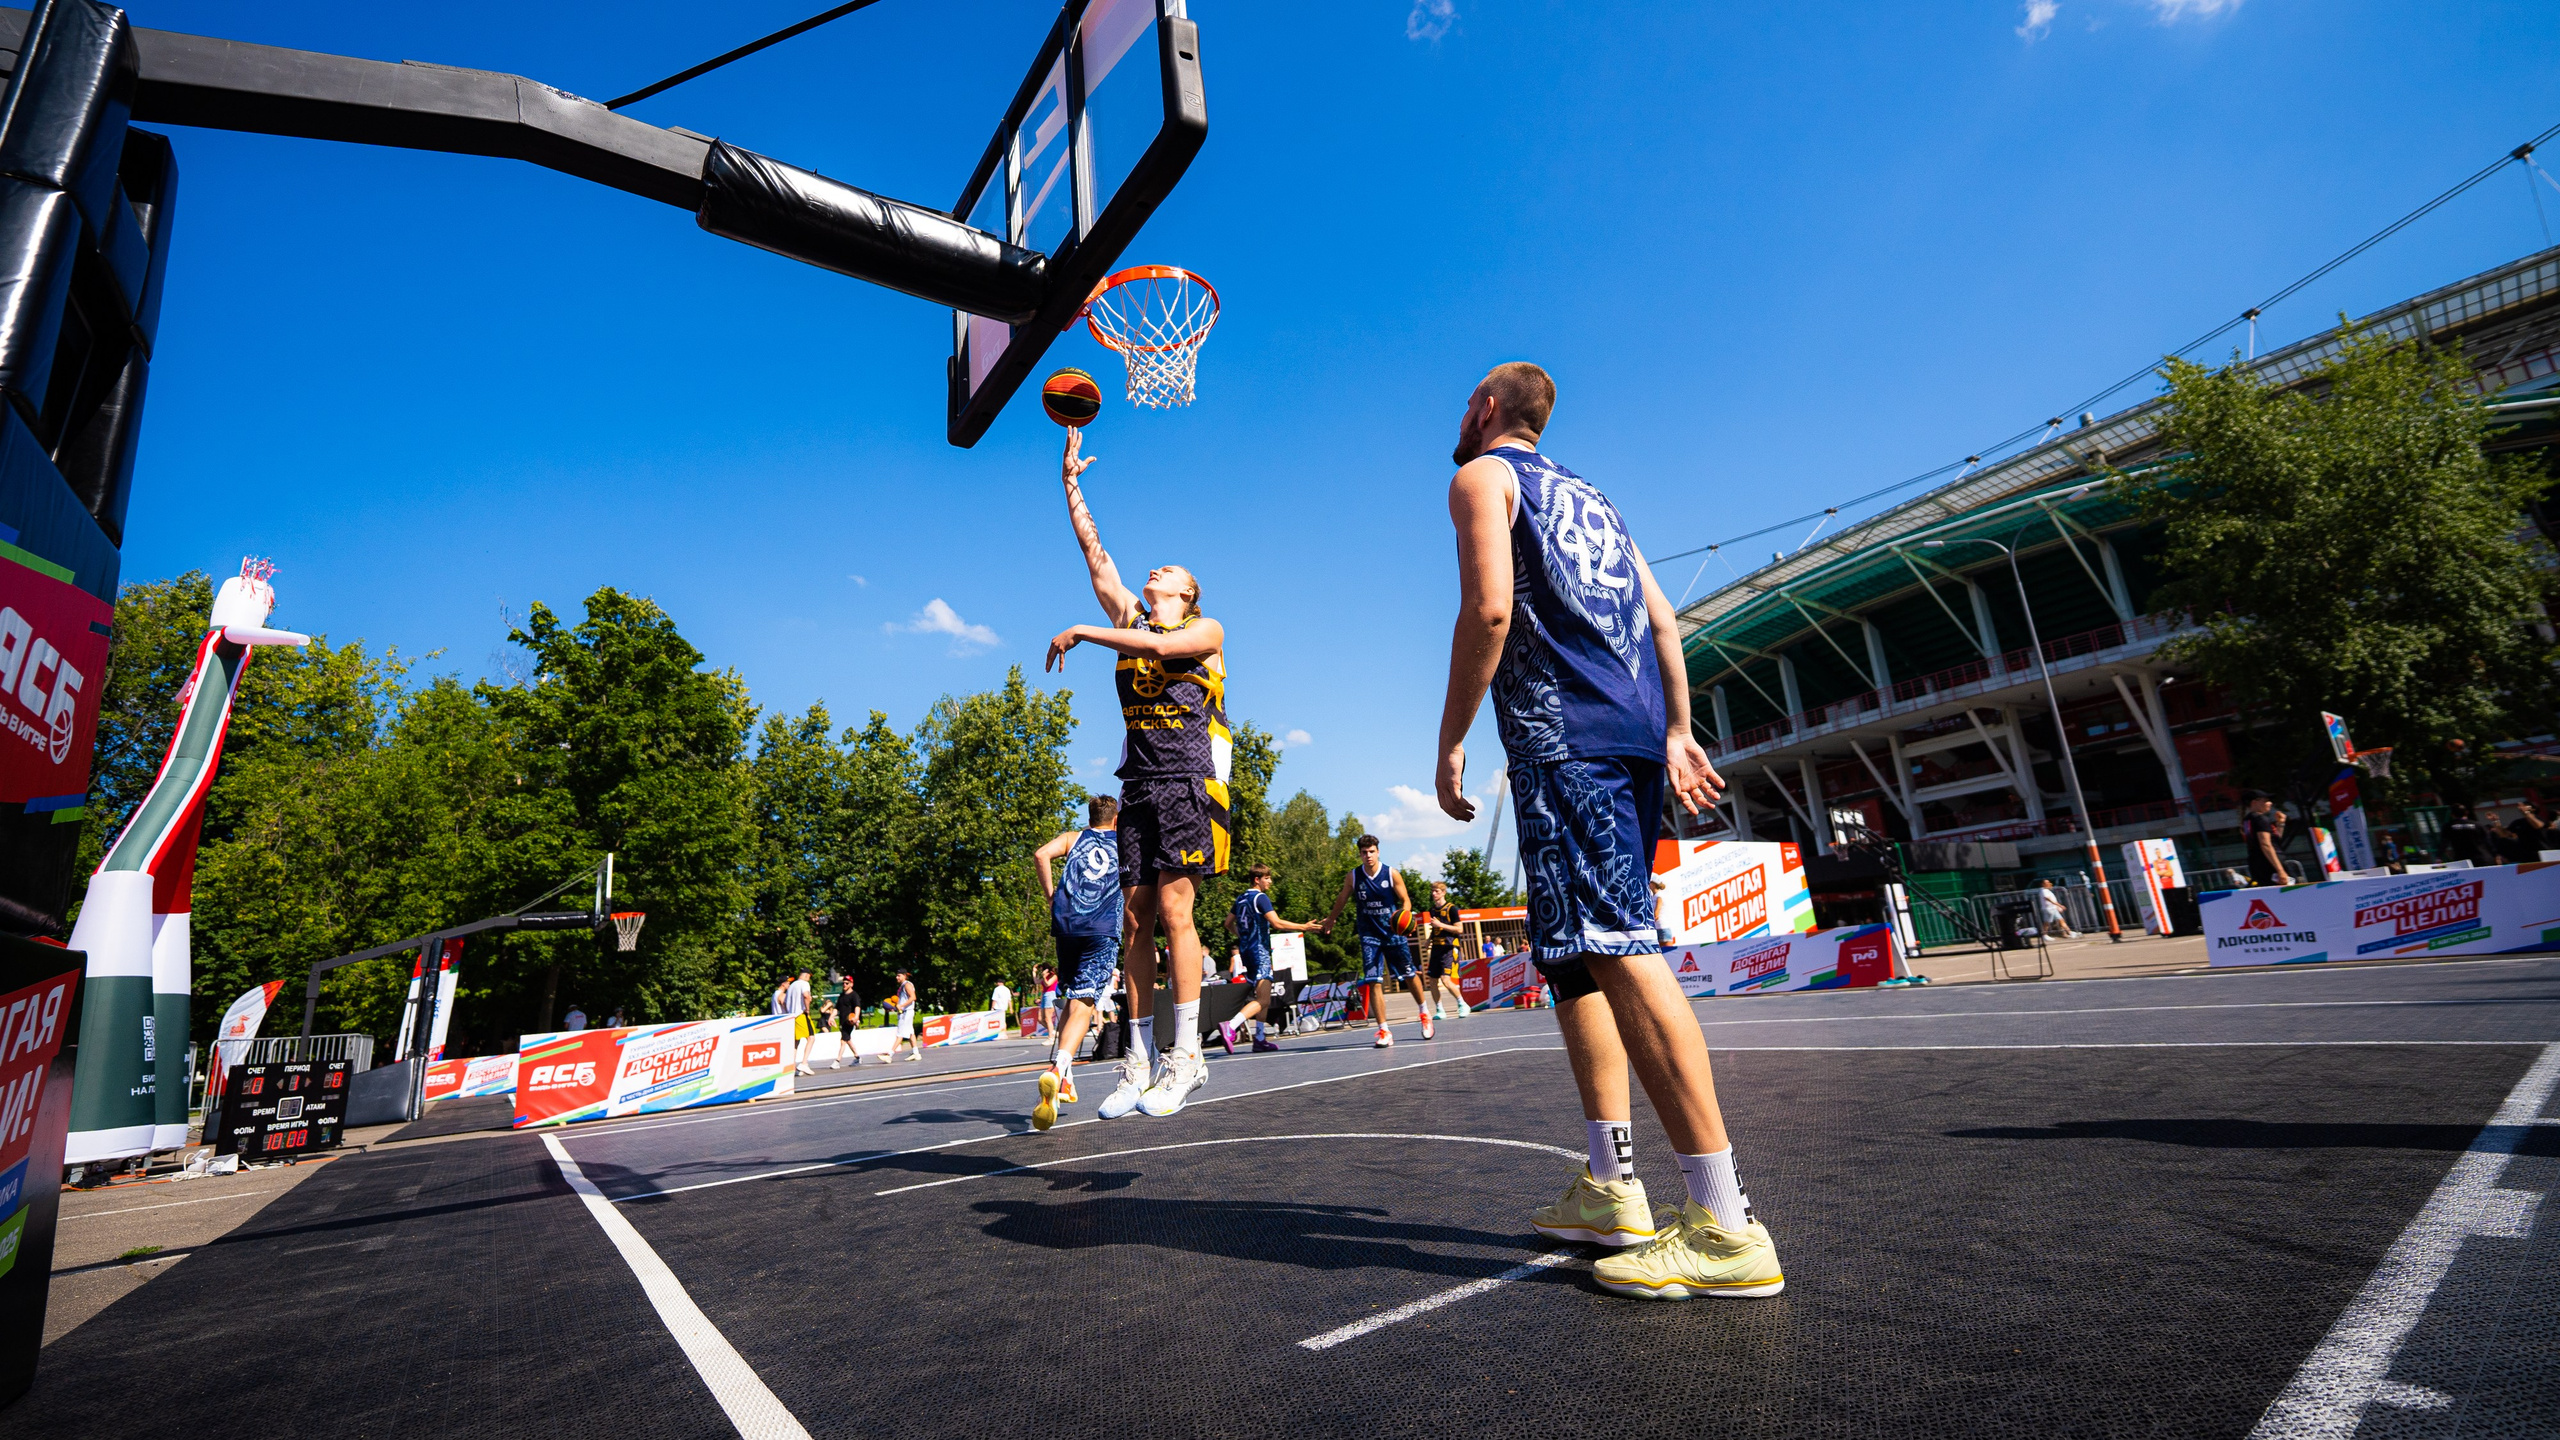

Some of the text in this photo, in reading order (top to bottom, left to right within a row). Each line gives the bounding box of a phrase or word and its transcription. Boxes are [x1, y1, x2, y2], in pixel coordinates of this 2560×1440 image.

[1556, 491, 1628, 588] 42
[0, 606, 84, 728] АСБ
[1122, 705, 1191, 717] АВТОДОР
[1083, 846, 1110, 880] 9
[1180, 849, 1206, 865] 14
[1687, 867, 1763, 929] ДОСТИГАЯ
[2360, 884, 2475, 926] ДОСТИГАЯ
[1241, 905, 1249, 929] 4
[1716, 893, 1767, 941] ЦЕЛИ!
[2401, 900, 2475, 931] ЦЕЛИ!
[2217, 931, 2317, 949] ЛОКОМОТИВ
[2244, 945, 2291, 953] КУБАНЬ
[1733, 945, 1787, 971] ДОСТИГАЯ
[1750, 956, 1785, 976] ЦЕЛИ!
[1462, 976, 1484, 990] АСБ
[1676, 974, 1713, 983] КОМОТИВ
[328, 1062, 346, 1070] СЧЕТ
[626, 1038, 715, 1077] ДОСТИГАЯ
[247, 1066, 266, 1075] СЧЕТ
[284, 1064, 311, 1073] ПЕРИОД
[529, 1061, 596, 1086] АСБ
[655, 1052, 710, 1081] ЦЕЛИ!
[426, 1073, 456, 1085] АСБ
[252, 1107, 276, 1117] ВРЕМЯ
[305, 1102, 326, 1111] АТАКИ
[267, 1119, 309, 1132] ВРЕМЯ ИГРЫ
[317, 1116, 339, 1125] ФОЛЫ
[233, 1126, 256, 1135] ФОЛЫ
